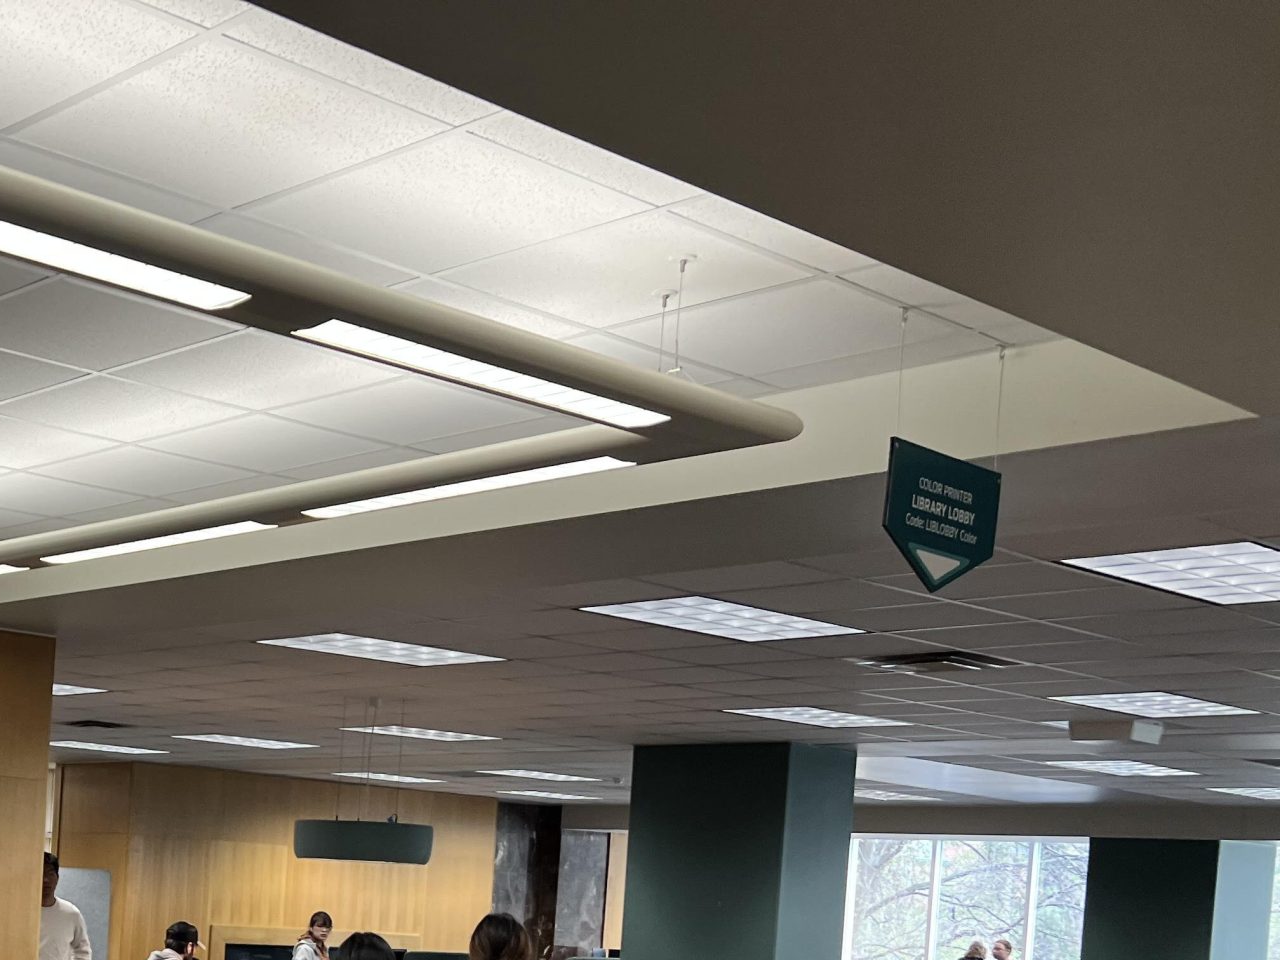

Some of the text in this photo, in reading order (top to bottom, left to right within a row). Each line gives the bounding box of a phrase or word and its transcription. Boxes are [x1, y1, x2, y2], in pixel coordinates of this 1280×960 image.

[919, 477, 973, 504] COLOR PRINTER
[911, 494, 976, 526] LIBRARY LOBBY
[925, 518, 959, 539] LIBLOBBY
[960, 529, 978, 545] Color
